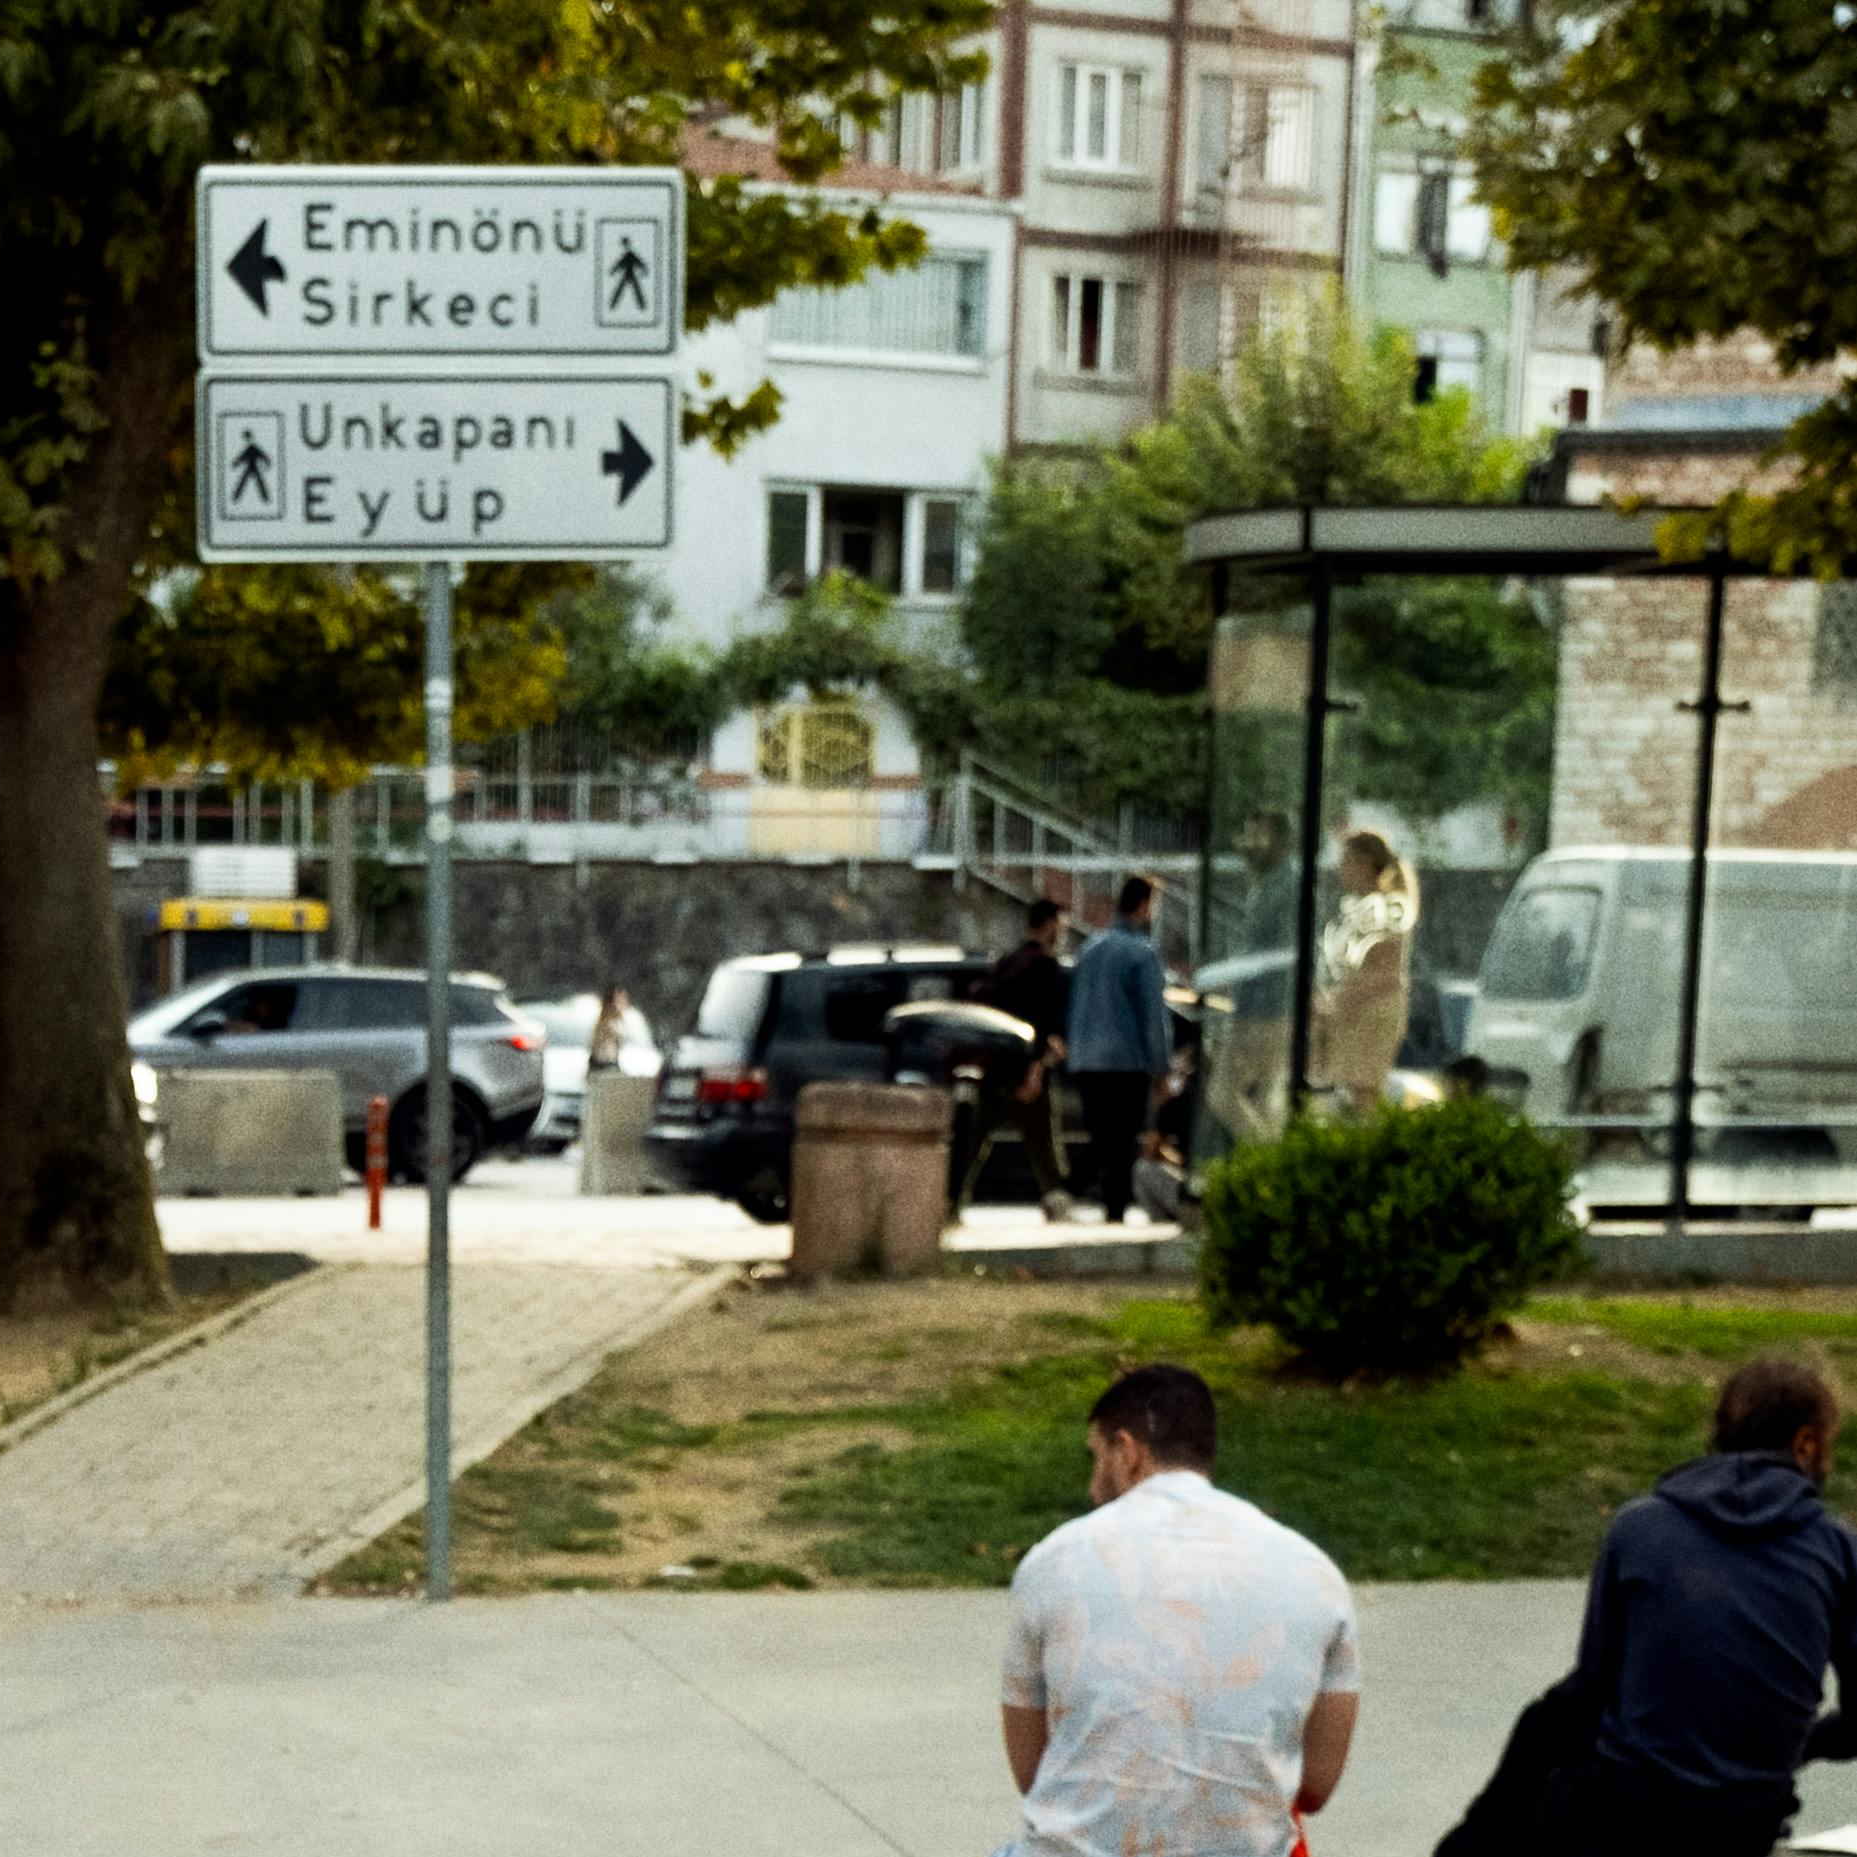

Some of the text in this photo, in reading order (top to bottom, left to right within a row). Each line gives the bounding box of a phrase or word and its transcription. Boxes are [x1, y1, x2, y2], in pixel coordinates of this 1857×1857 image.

[304, 202, 587, 254] Eminönü
[301, 277, 540, 328] Sirkeci
[298, 401, 576, 464] Unkapanı
[303, 475, 506, 538] Eyüp
